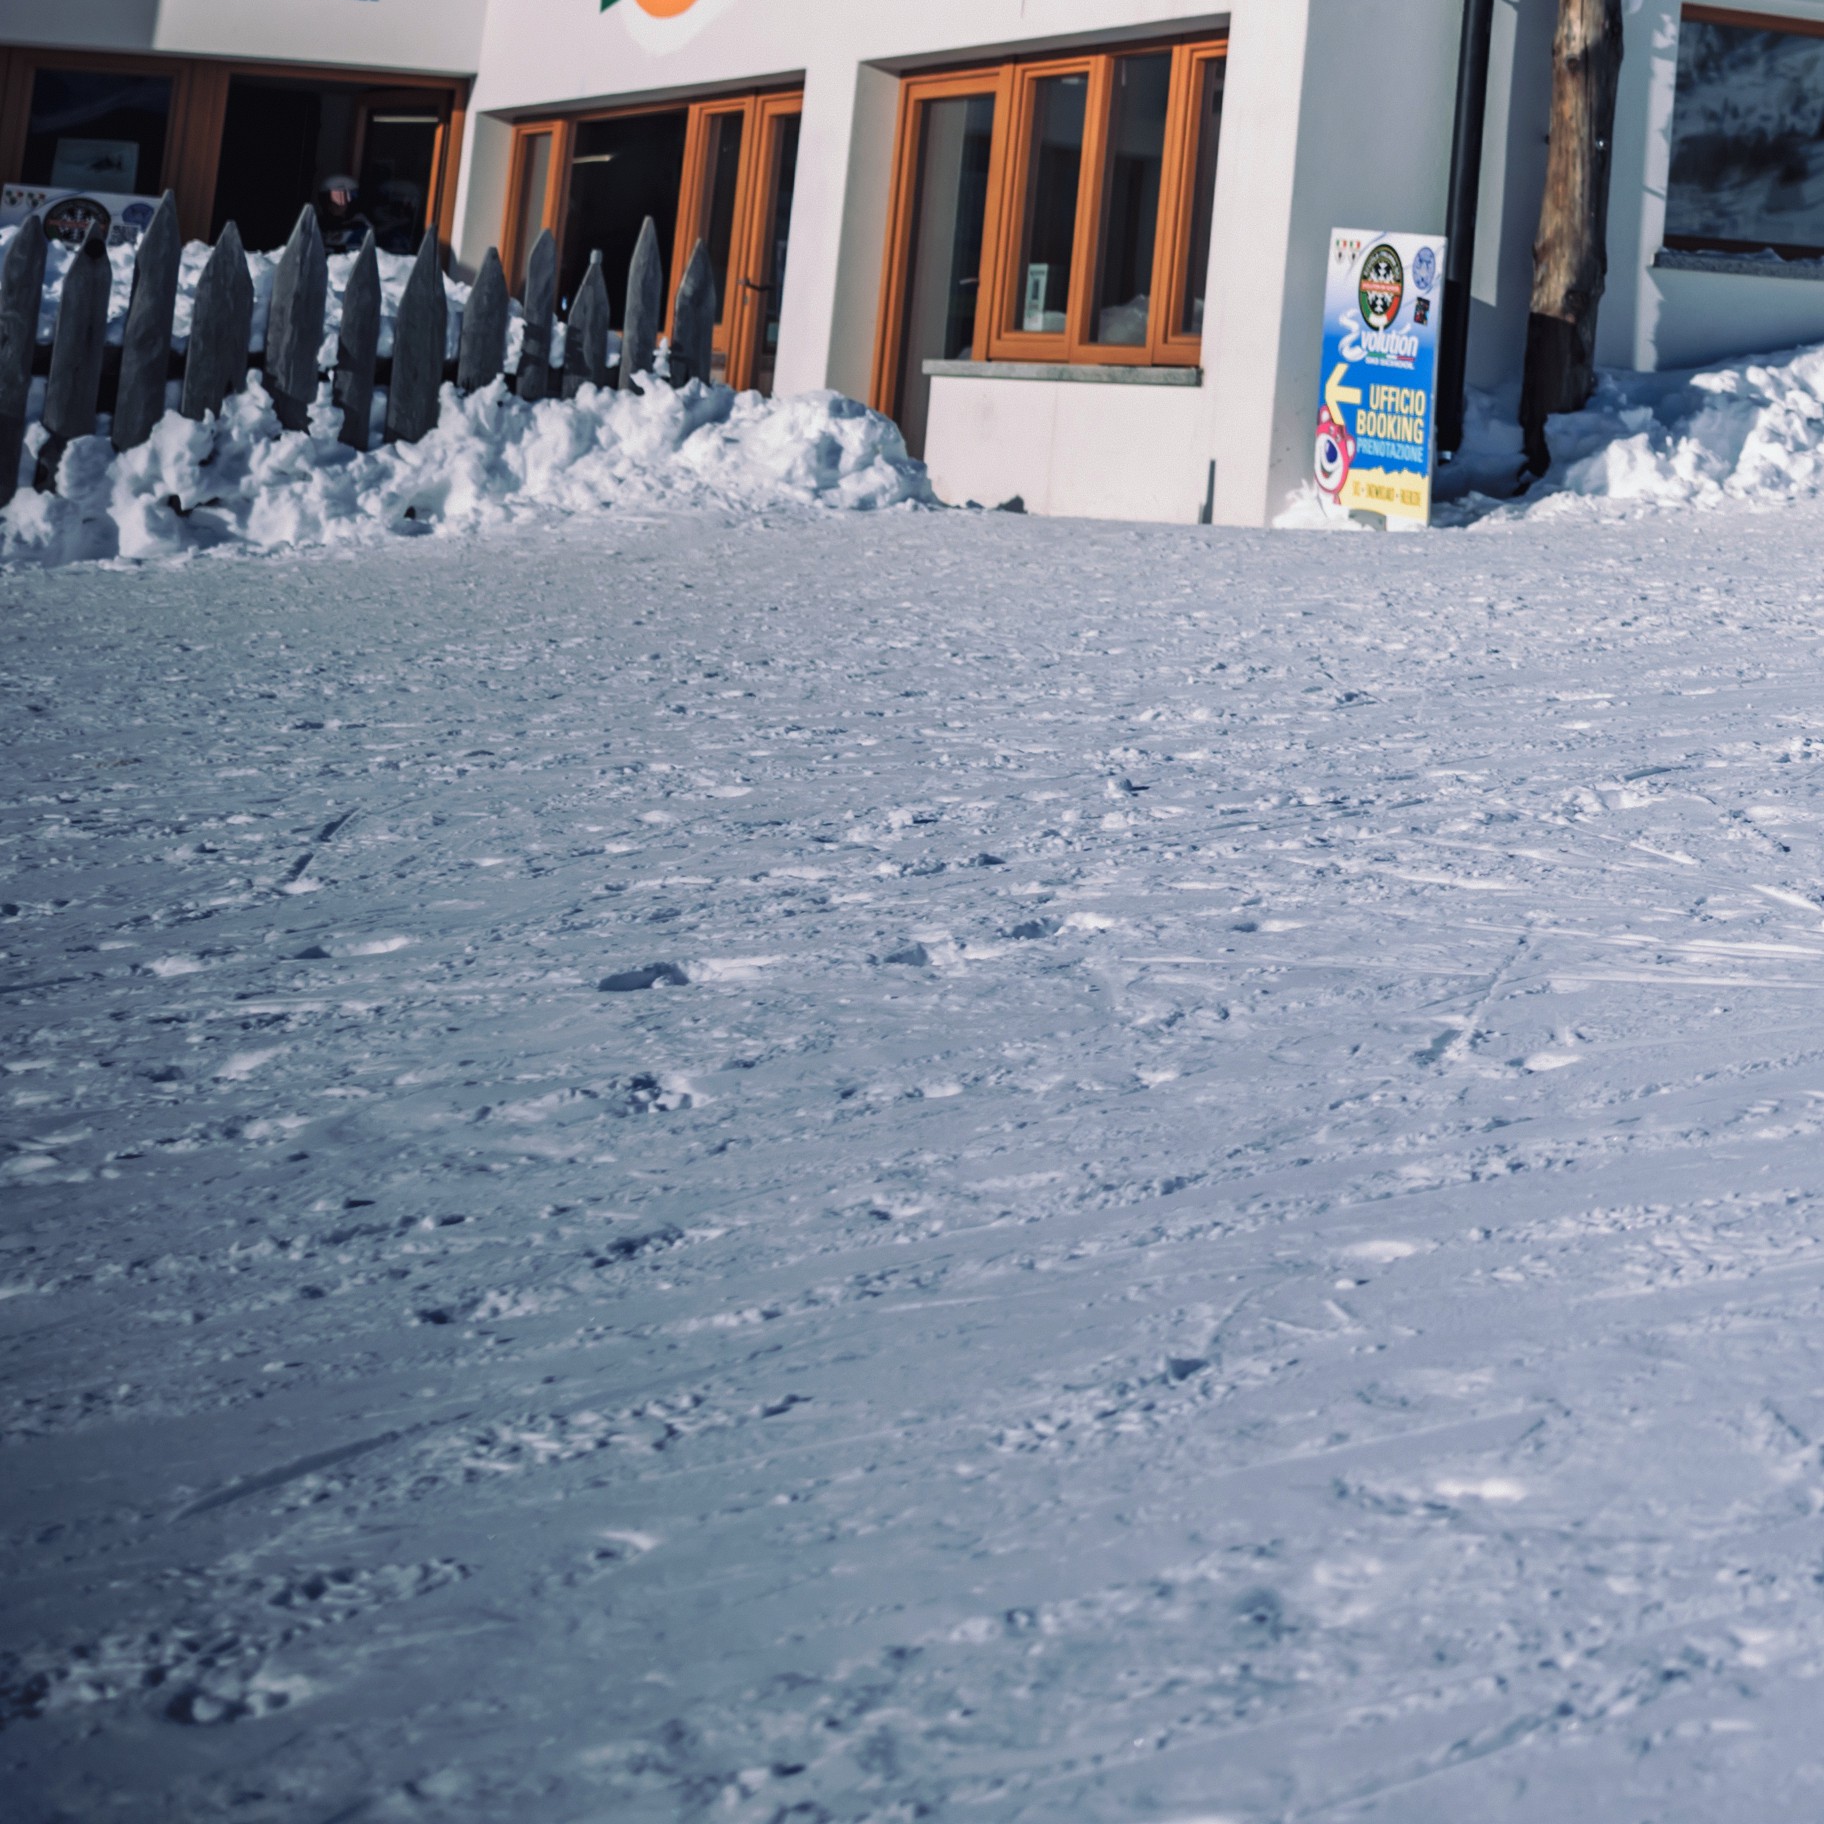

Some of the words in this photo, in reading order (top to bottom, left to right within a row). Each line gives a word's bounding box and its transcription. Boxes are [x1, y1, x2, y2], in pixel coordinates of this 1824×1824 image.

[1369, 383, 1426, 416] UFFICIO
[1356, 409, 1424, 445] BOOKING
[1356, 436, 1423, 463] PRENOTAZIONE
